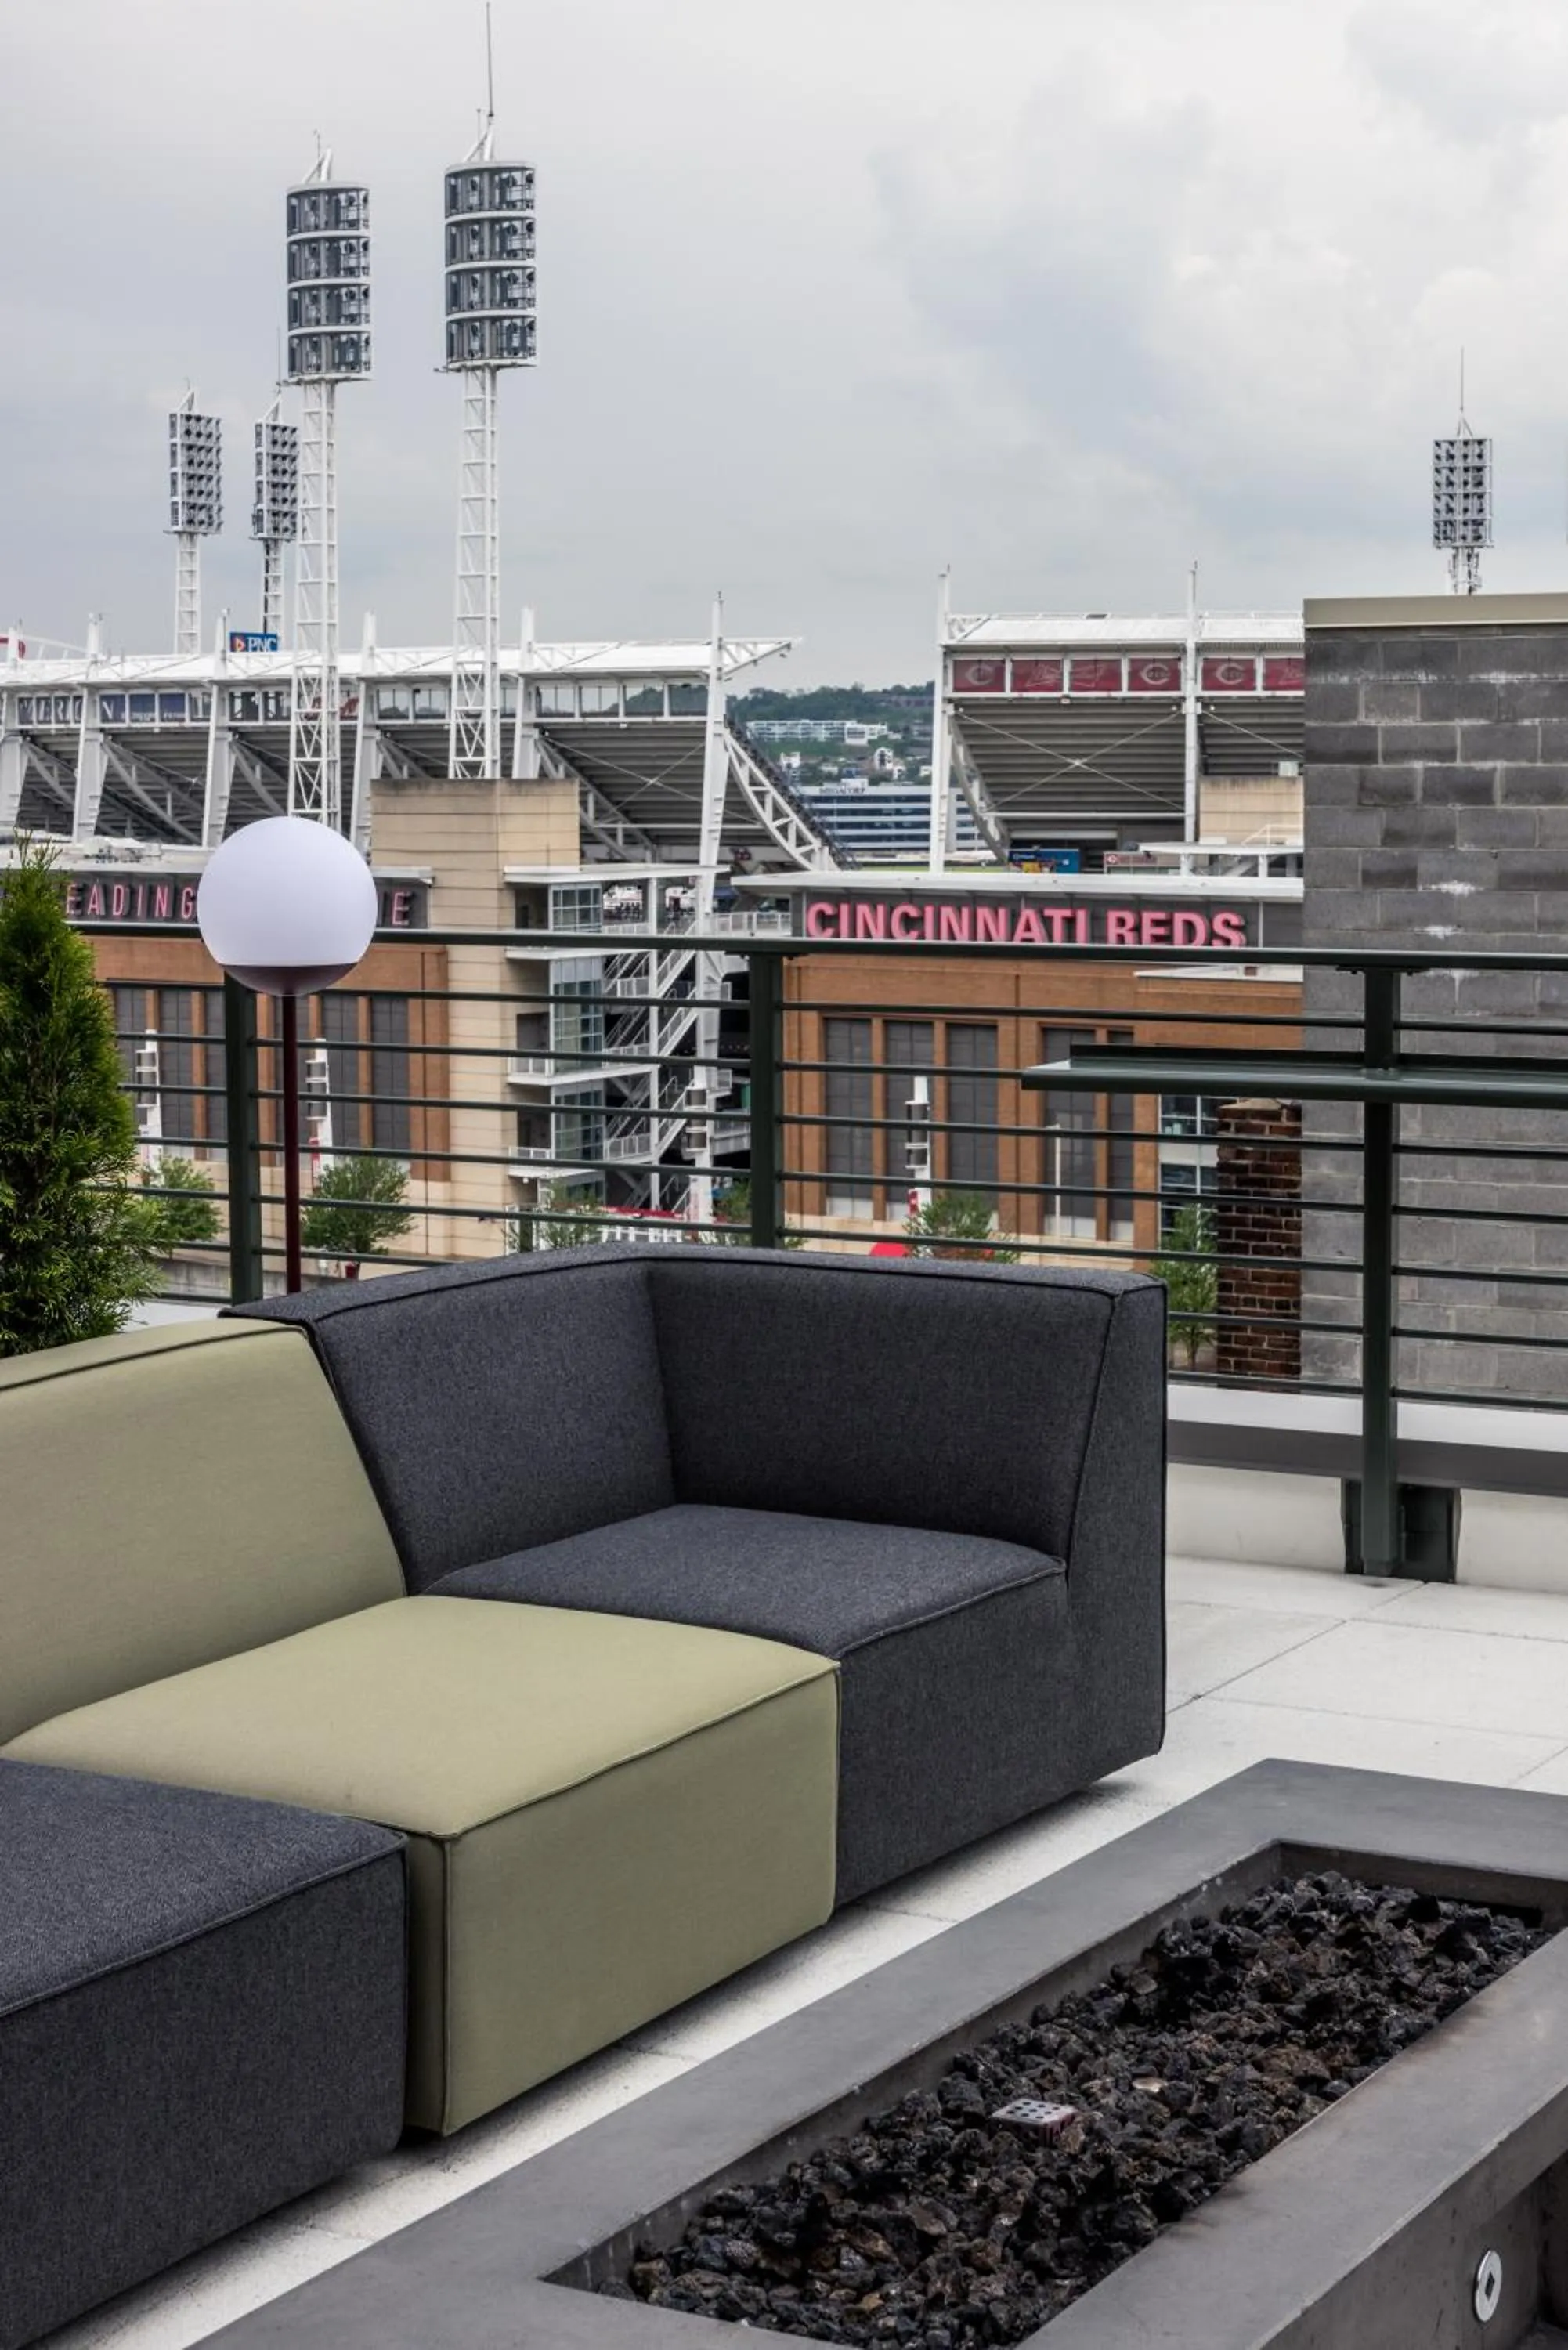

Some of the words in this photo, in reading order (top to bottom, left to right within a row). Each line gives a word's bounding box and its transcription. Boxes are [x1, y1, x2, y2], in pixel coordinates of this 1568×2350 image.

[247, 635, 277, 653] PNC
[66, 883, 195, 920] EADING
[807, 902, 1090, 945] CINCINNATI
[1107, 909, 1247, 949] REDS
